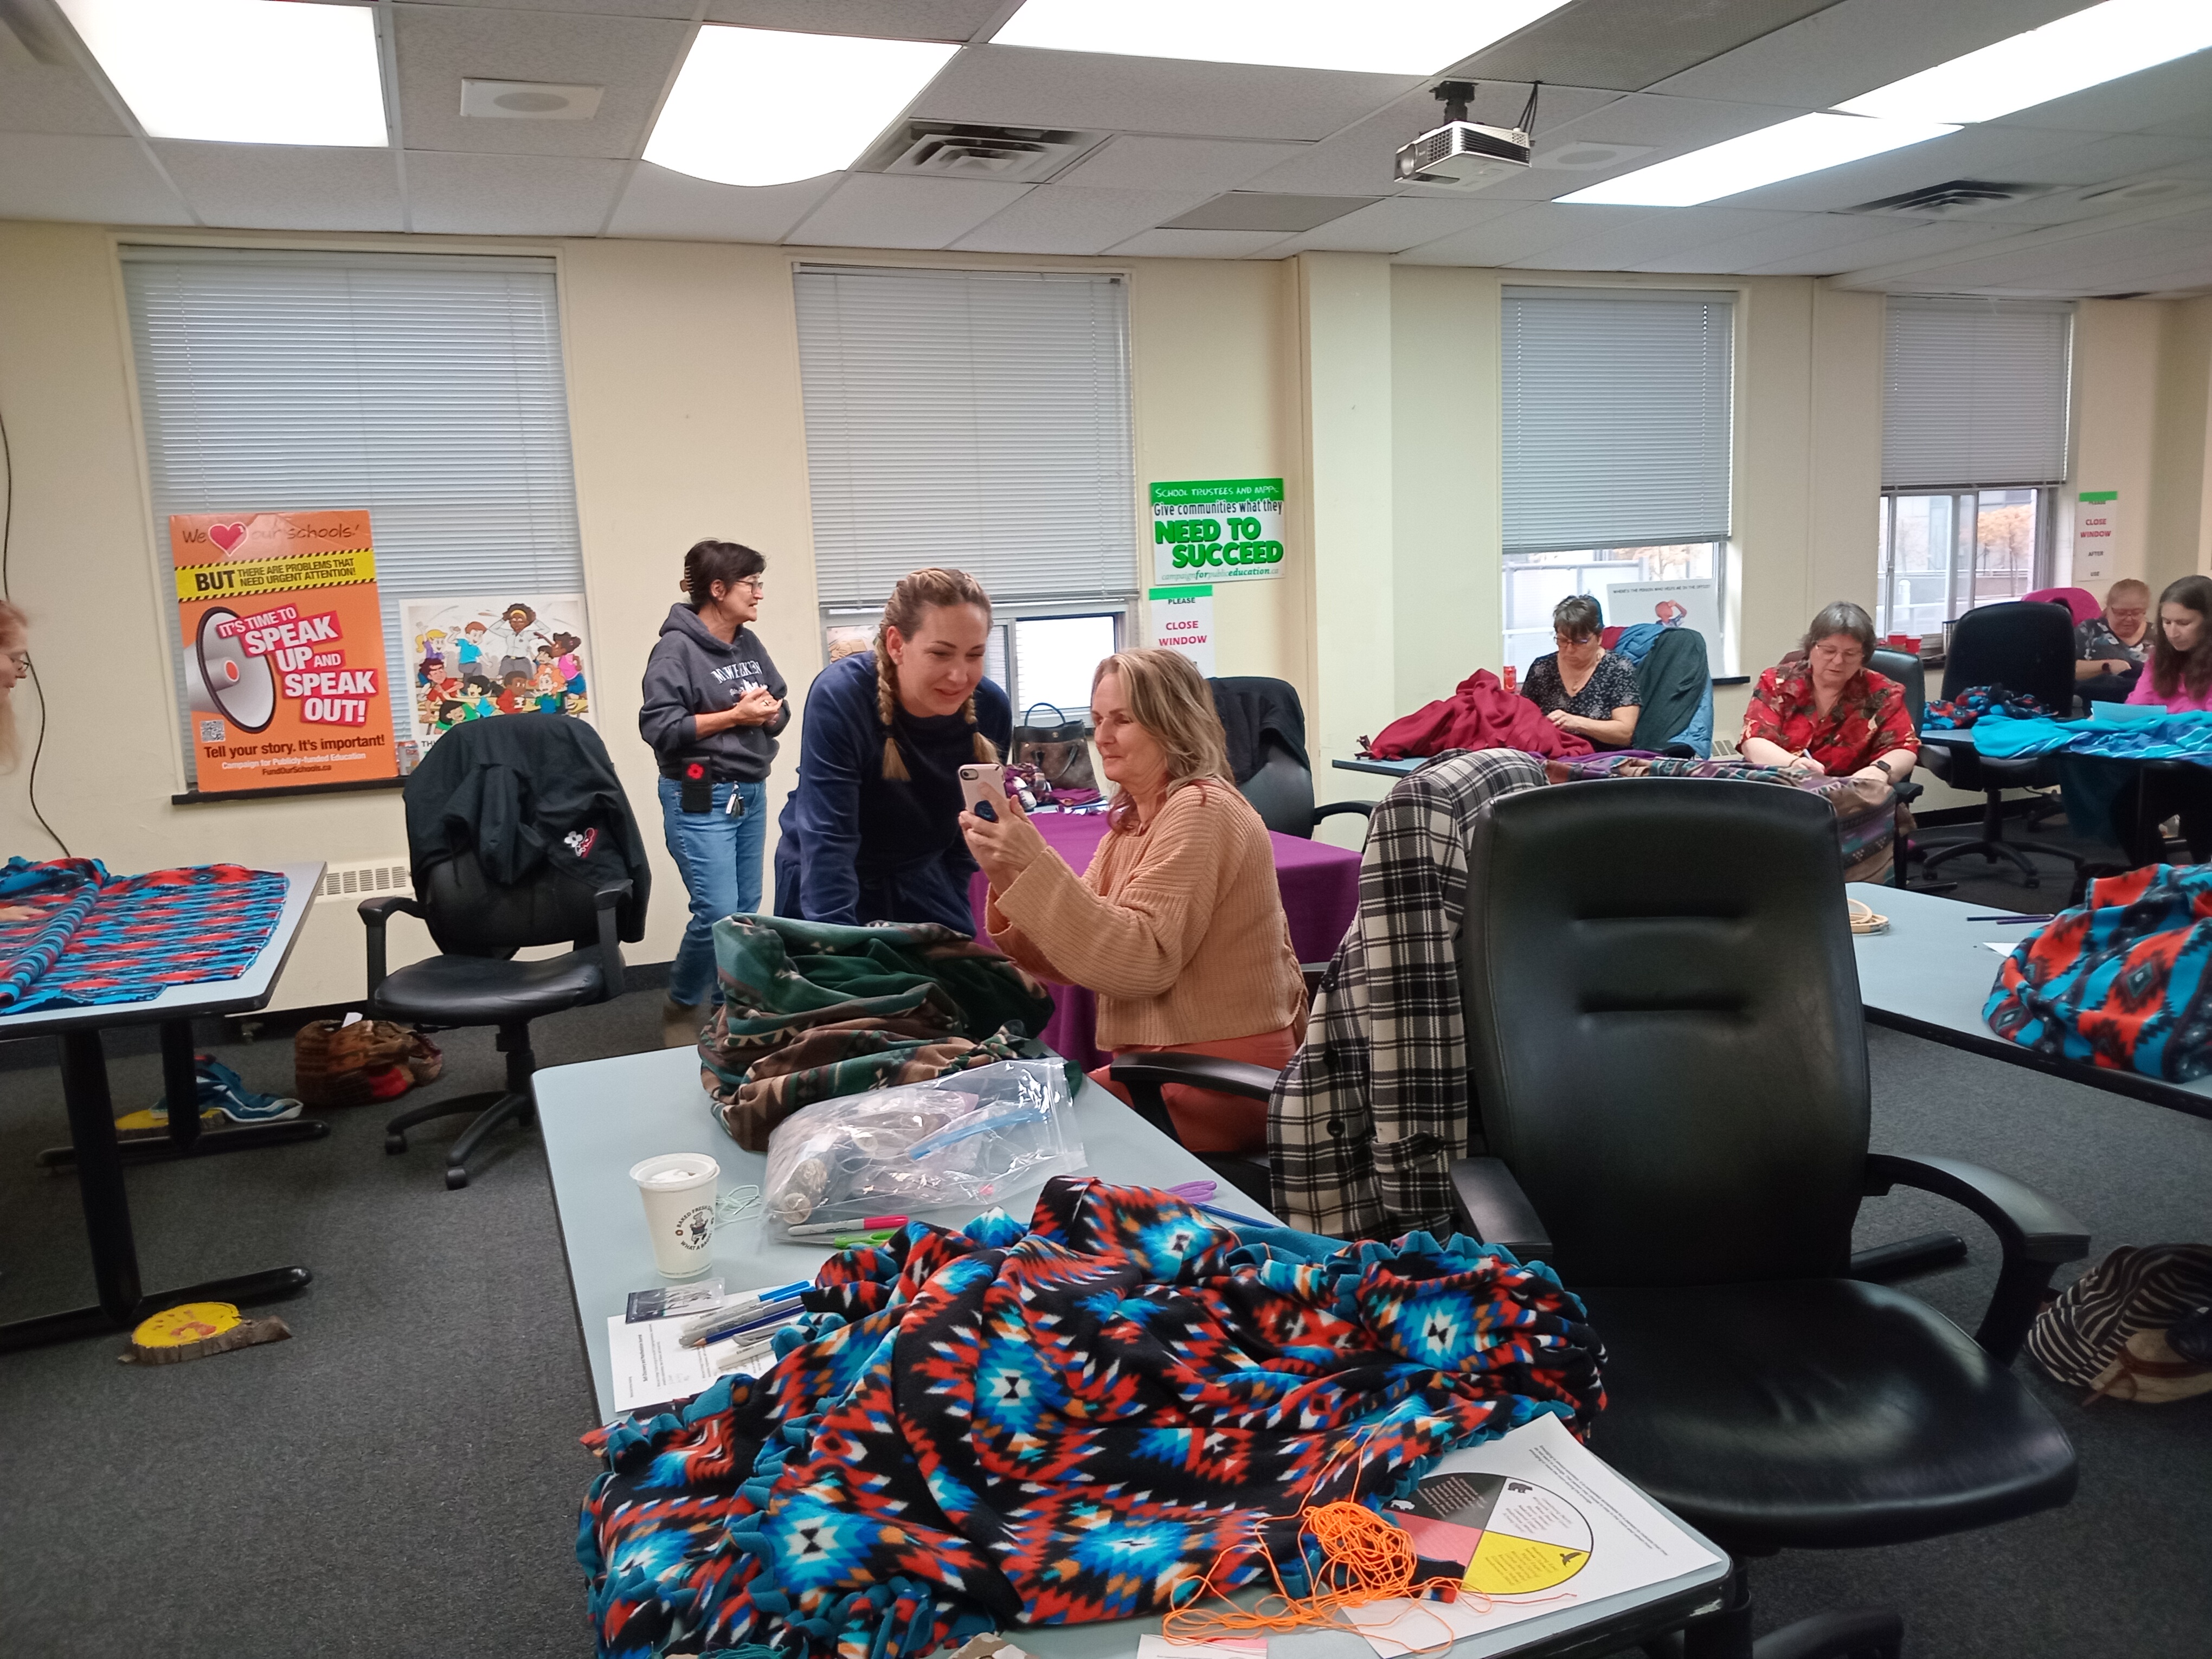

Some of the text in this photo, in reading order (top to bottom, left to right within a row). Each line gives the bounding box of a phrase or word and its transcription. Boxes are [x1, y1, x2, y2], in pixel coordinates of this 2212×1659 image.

[1155, 488, 1188, 498] SCHOOL
[1191, 487, 1234, 496] TRUSTEES
[1236, 486, 1252, 494] AND
[1154, 498, 1283, 516] Give communities what they
[183, 528, 207, 544] We
[287, 524, 359, 539] schools!
[1155, 517, 1262, 544] NEED TO
[1172, 540, 1284, 569] SUCCEED
[237, 557, 355, 578] THERE ARE PROBLEMS THAT
[240, 567, 356, 587] NEED URGENT ATTENTION!
[195, 570, 235, 591] BUT
[1168, 597, 1196, 605] PLEASE
[218, 606, 298, 638] IT'S TIME TO
[1166, 621, 1199, 631] CLOSE
[246, 615, 338, 654] SPEAK
[1159, 635, 1207, 646] WINDOW
[276, 646, 342, 672] UP AND
[286, 673, 376, 697] SPEAK
[304, 699, 365, 723] OUT!
[204, 734, 385, 759] Tell your story. It's important!
[222, 760, 259, 770] Campaign
[260, 758, 271, 767] for
[330, 752, 366, 761] Education
[680, 1240, 696, 1250] WHAT
